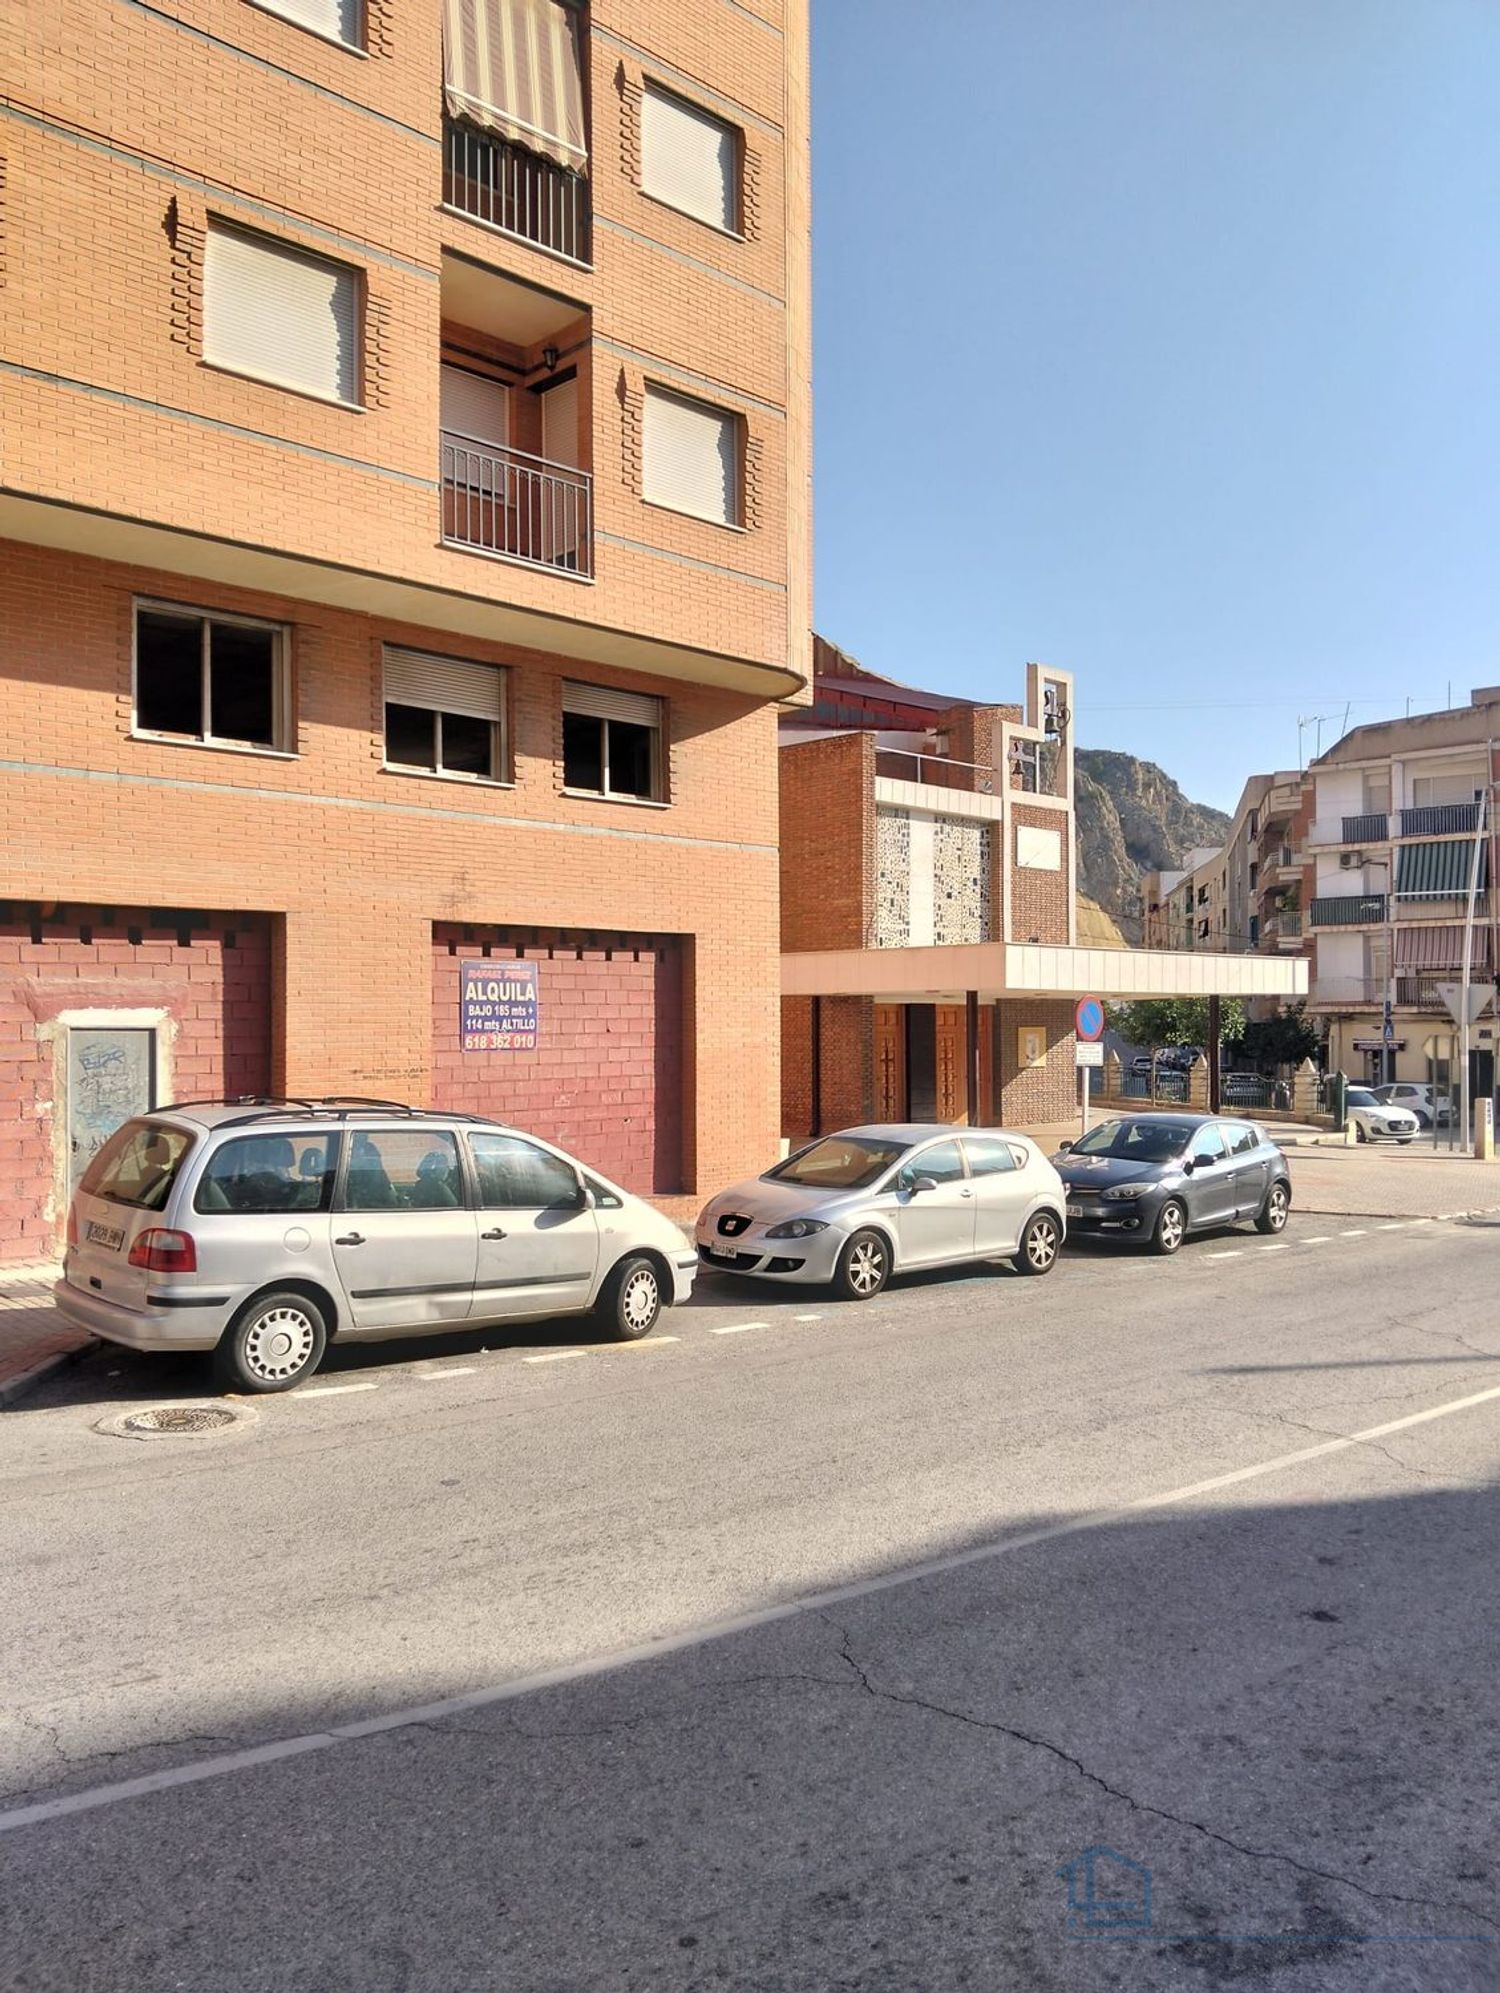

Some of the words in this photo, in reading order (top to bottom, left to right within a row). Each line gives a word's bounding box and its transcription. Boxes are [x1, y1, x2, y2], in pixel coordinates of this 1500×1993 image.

[466, 982, 535, 1001] ALQUILA
[468, 1005, 492, 1016] BAJO
[511, 1007, 526, 1016] mts
[466, 1019, 482, 1030] 114
[484, 1020, 501, 1030] mts
[502, 1019, 535, 1030] ALTILLO
[466, 1036, 487, 1049] 618
[514, 1035, 534, 1048] 010
